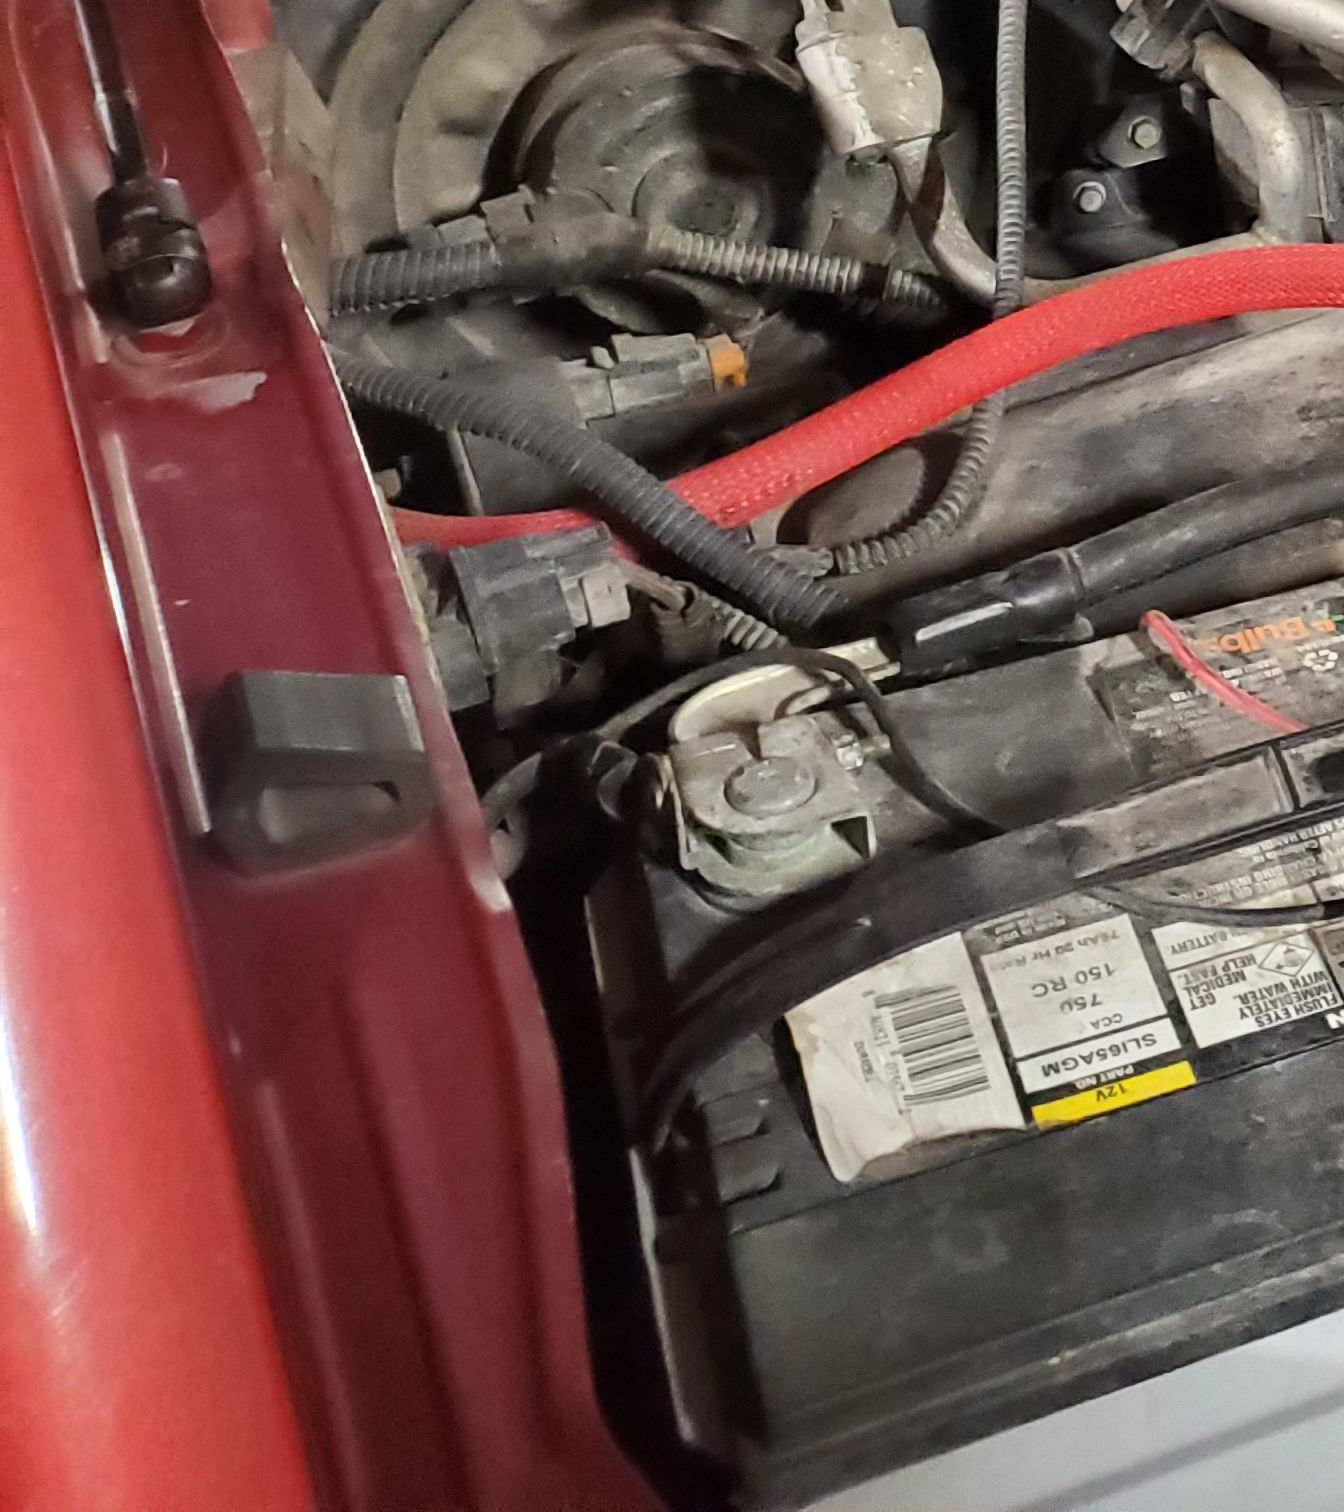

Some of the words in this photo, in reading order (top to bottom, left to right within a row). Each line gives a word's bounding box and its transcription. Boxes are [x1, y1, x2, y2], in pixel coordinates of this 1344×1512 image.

[1031, 947, 1051, 963] Hr
[1218, 952, 1256, 974] HELP
[1072, 960, 1117, 986] 150
[1176, 963, 1219, 987] FAST.
[1181, 968, 1246, 999] MEDICAL
[1287, 968, 1328, 990] WITH
[1029, 975, 1067, 999] RC
[1231, 980, 1288, 1007] WATER.
[1057, 990, 1103, 1016] 750
[1187, 991, 1216, 1010] GET
[1236, 979, 1332, 1020] IMMEDIATELY
[1290, 991, 1338, 1016] FLUSH
[1088, 1011, 1124, 1031] CCA
[1253, 1006, 1292, 1028] EYES
[1040, 1030, 1157, 1078] SLI65AGM
[1098, 1063, 1134, 1082] PART
[1092, 1080, 1129, 1103] 12V
